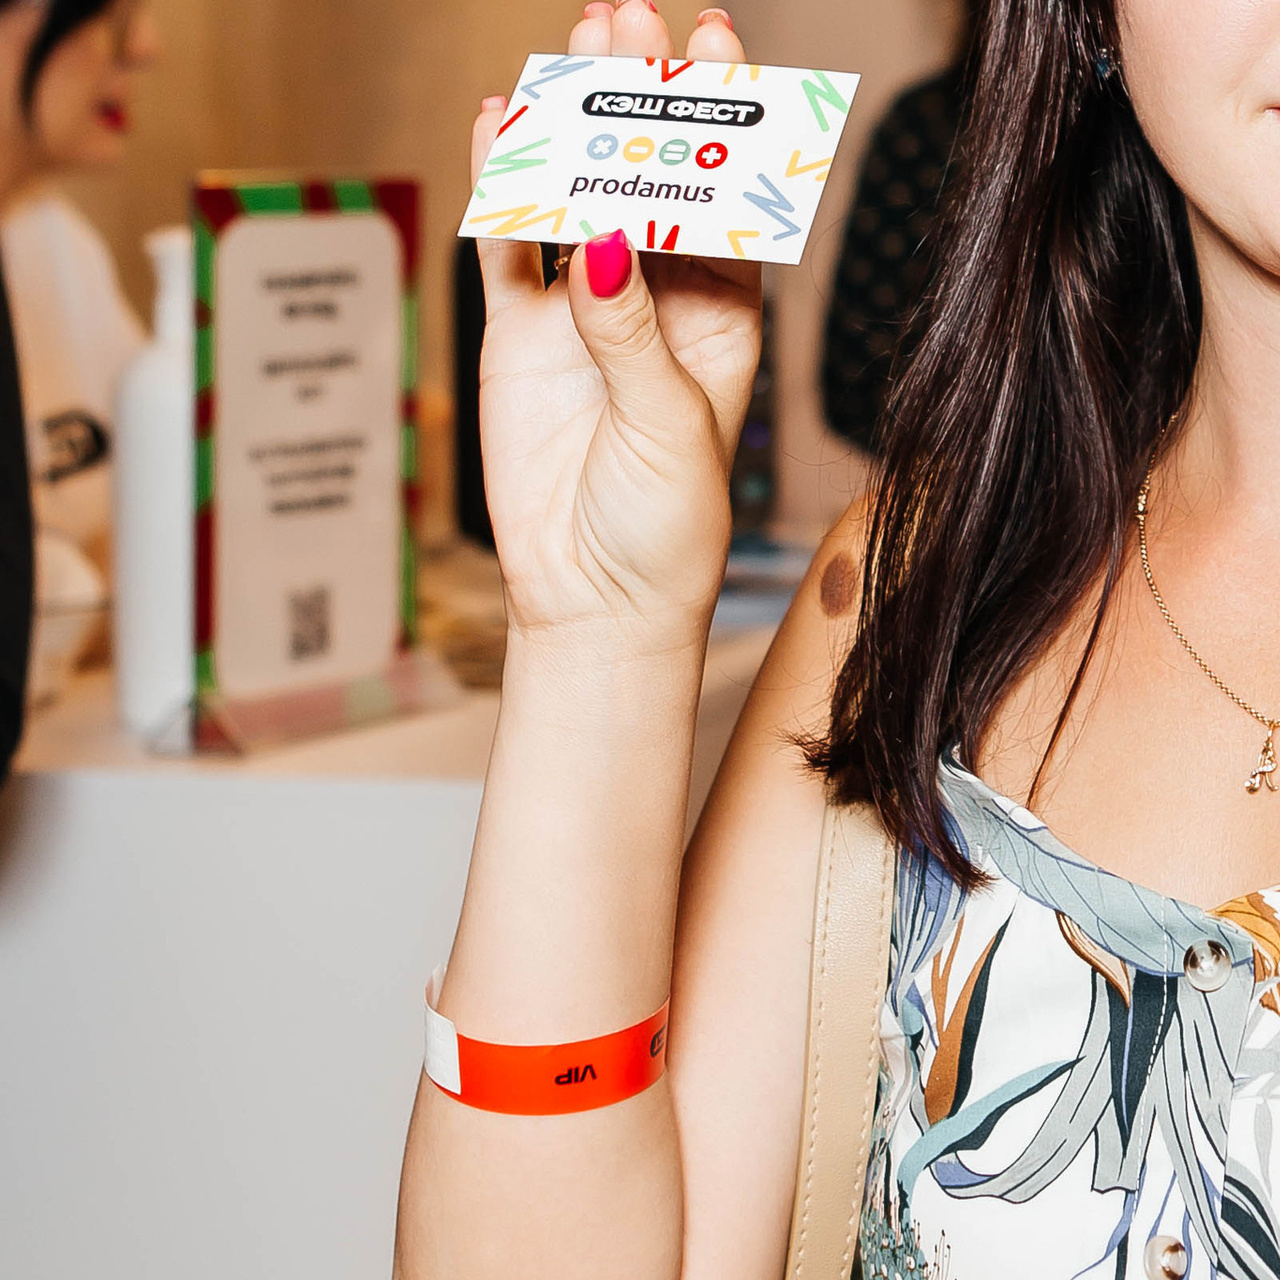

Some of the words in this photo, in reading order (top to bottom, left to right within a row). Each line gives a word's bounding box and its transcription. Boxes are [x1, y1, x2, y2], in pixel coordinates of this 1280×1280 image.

[591, 94, 663, 116] КЭШ
[667, 99, 756, 123] ФЕСТ
[569, 174, 716, 203] prodamus
[555, 1064, 597, 1085] VIP
